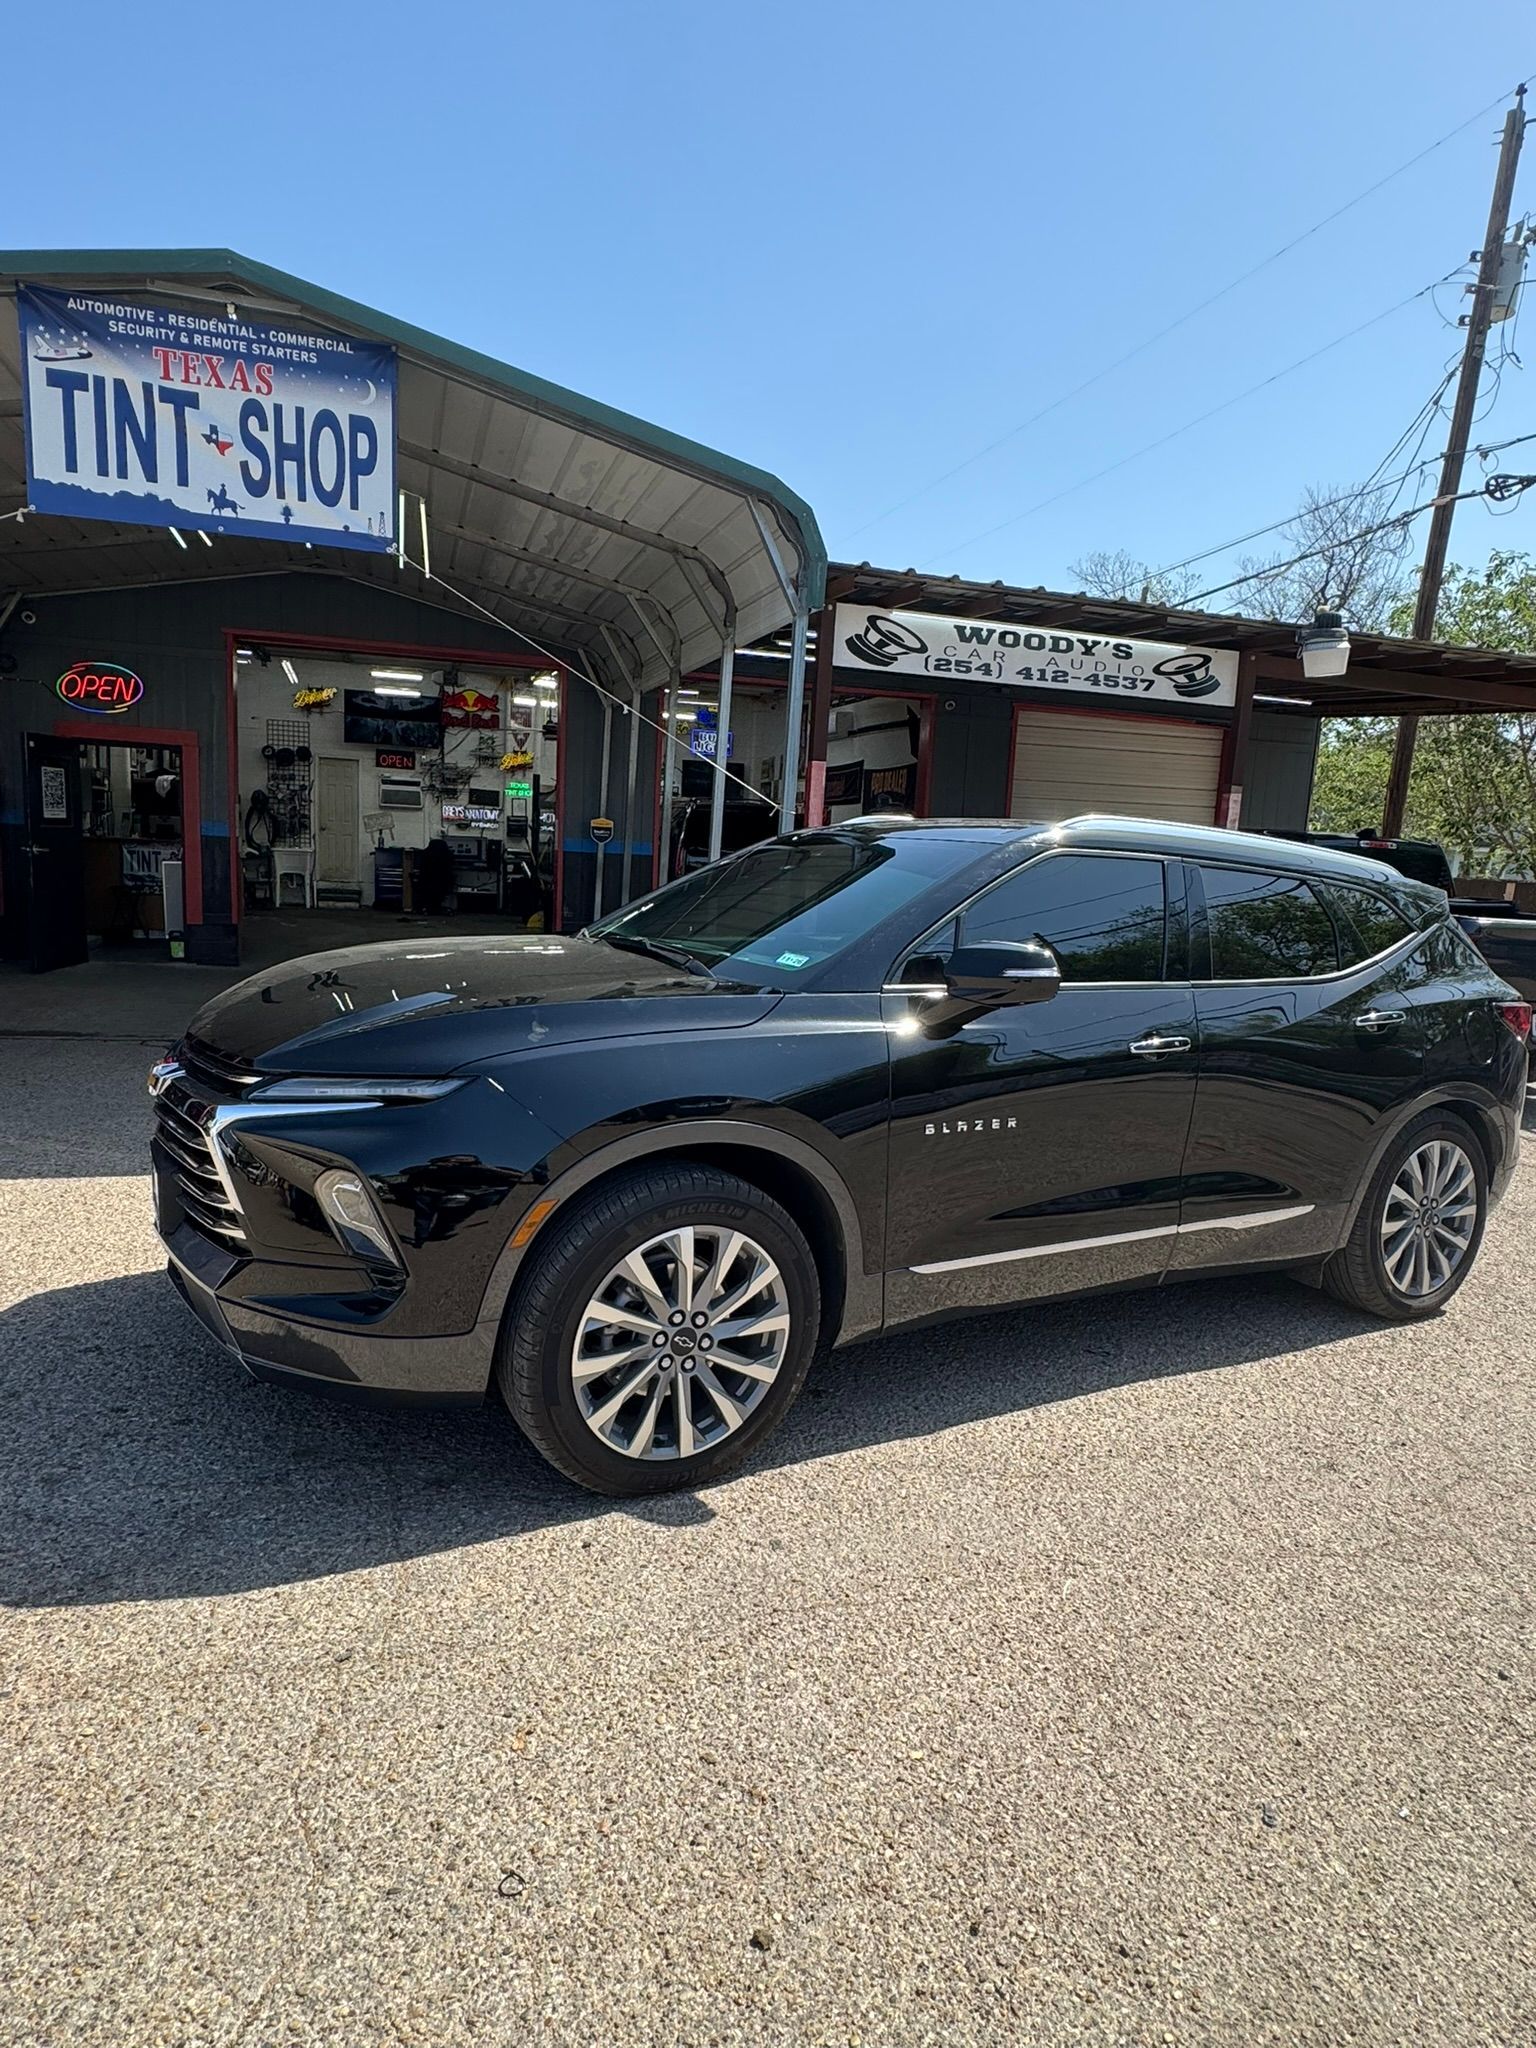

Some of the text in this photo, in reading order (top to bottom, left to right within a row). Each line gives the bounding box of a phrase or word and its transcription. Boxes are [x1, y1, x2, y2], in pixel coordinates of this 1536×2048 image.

[67, 297, 355, 355] AUTOMOTIVE RESIDENTIAL COMMERCIAL
[108, 320, 318, 364] SECURITY & REMOTE STARTERS
[152, 346, 274, 397] TEXAS
[46, 367, 379, 511] TINT SHOP
[953, 624, 1133, 661] WOODY'S
[923, 654, 1156, 693] (254) 412-4537
[943, 645, 1146, 677] CAR AUDIO
[61, 674, 136, 701] OPEN
[379, 755, 413, 768] OPEN
[127, 850, 161, 873] TINT
[925, 1117, 1017, 1135] BLAZER
[665, 1201, 747, 1220] MICHELIN
